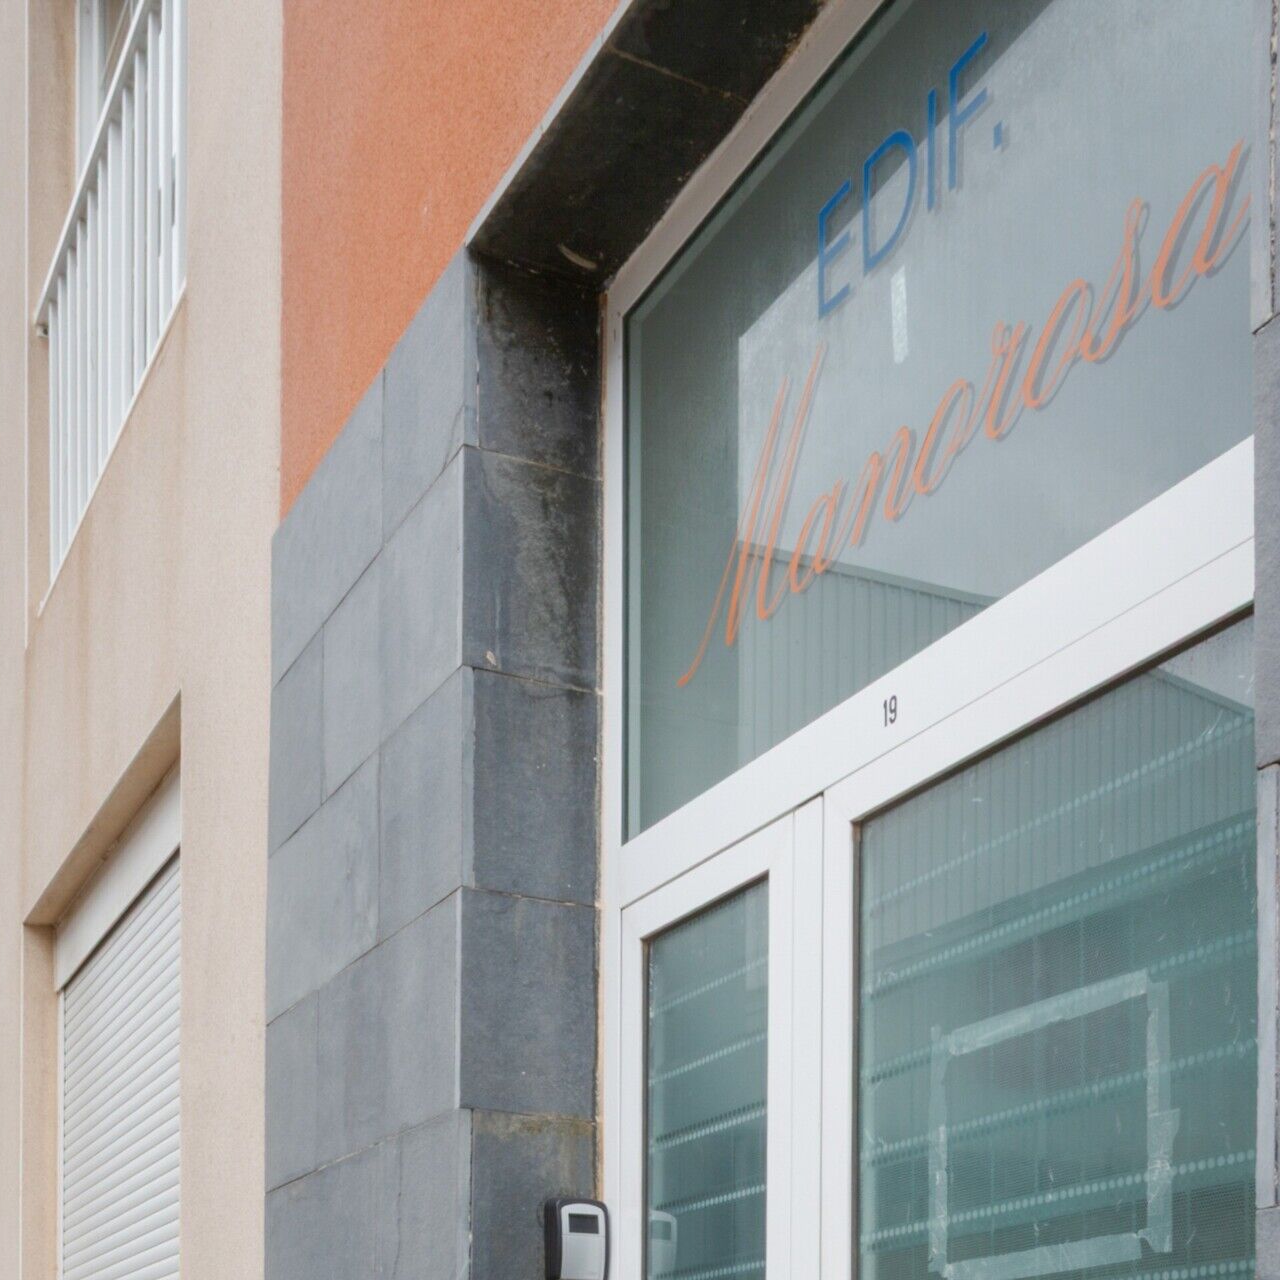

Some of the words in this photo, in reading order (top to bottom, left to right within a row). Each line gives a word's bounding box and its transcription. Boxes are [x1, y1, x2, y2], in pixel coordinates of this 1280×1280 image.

[818, 30, 1004, 320] EDIF.
[677, 138, 1253, 688] Manorosa
[883, 695, 897, 727] 19
